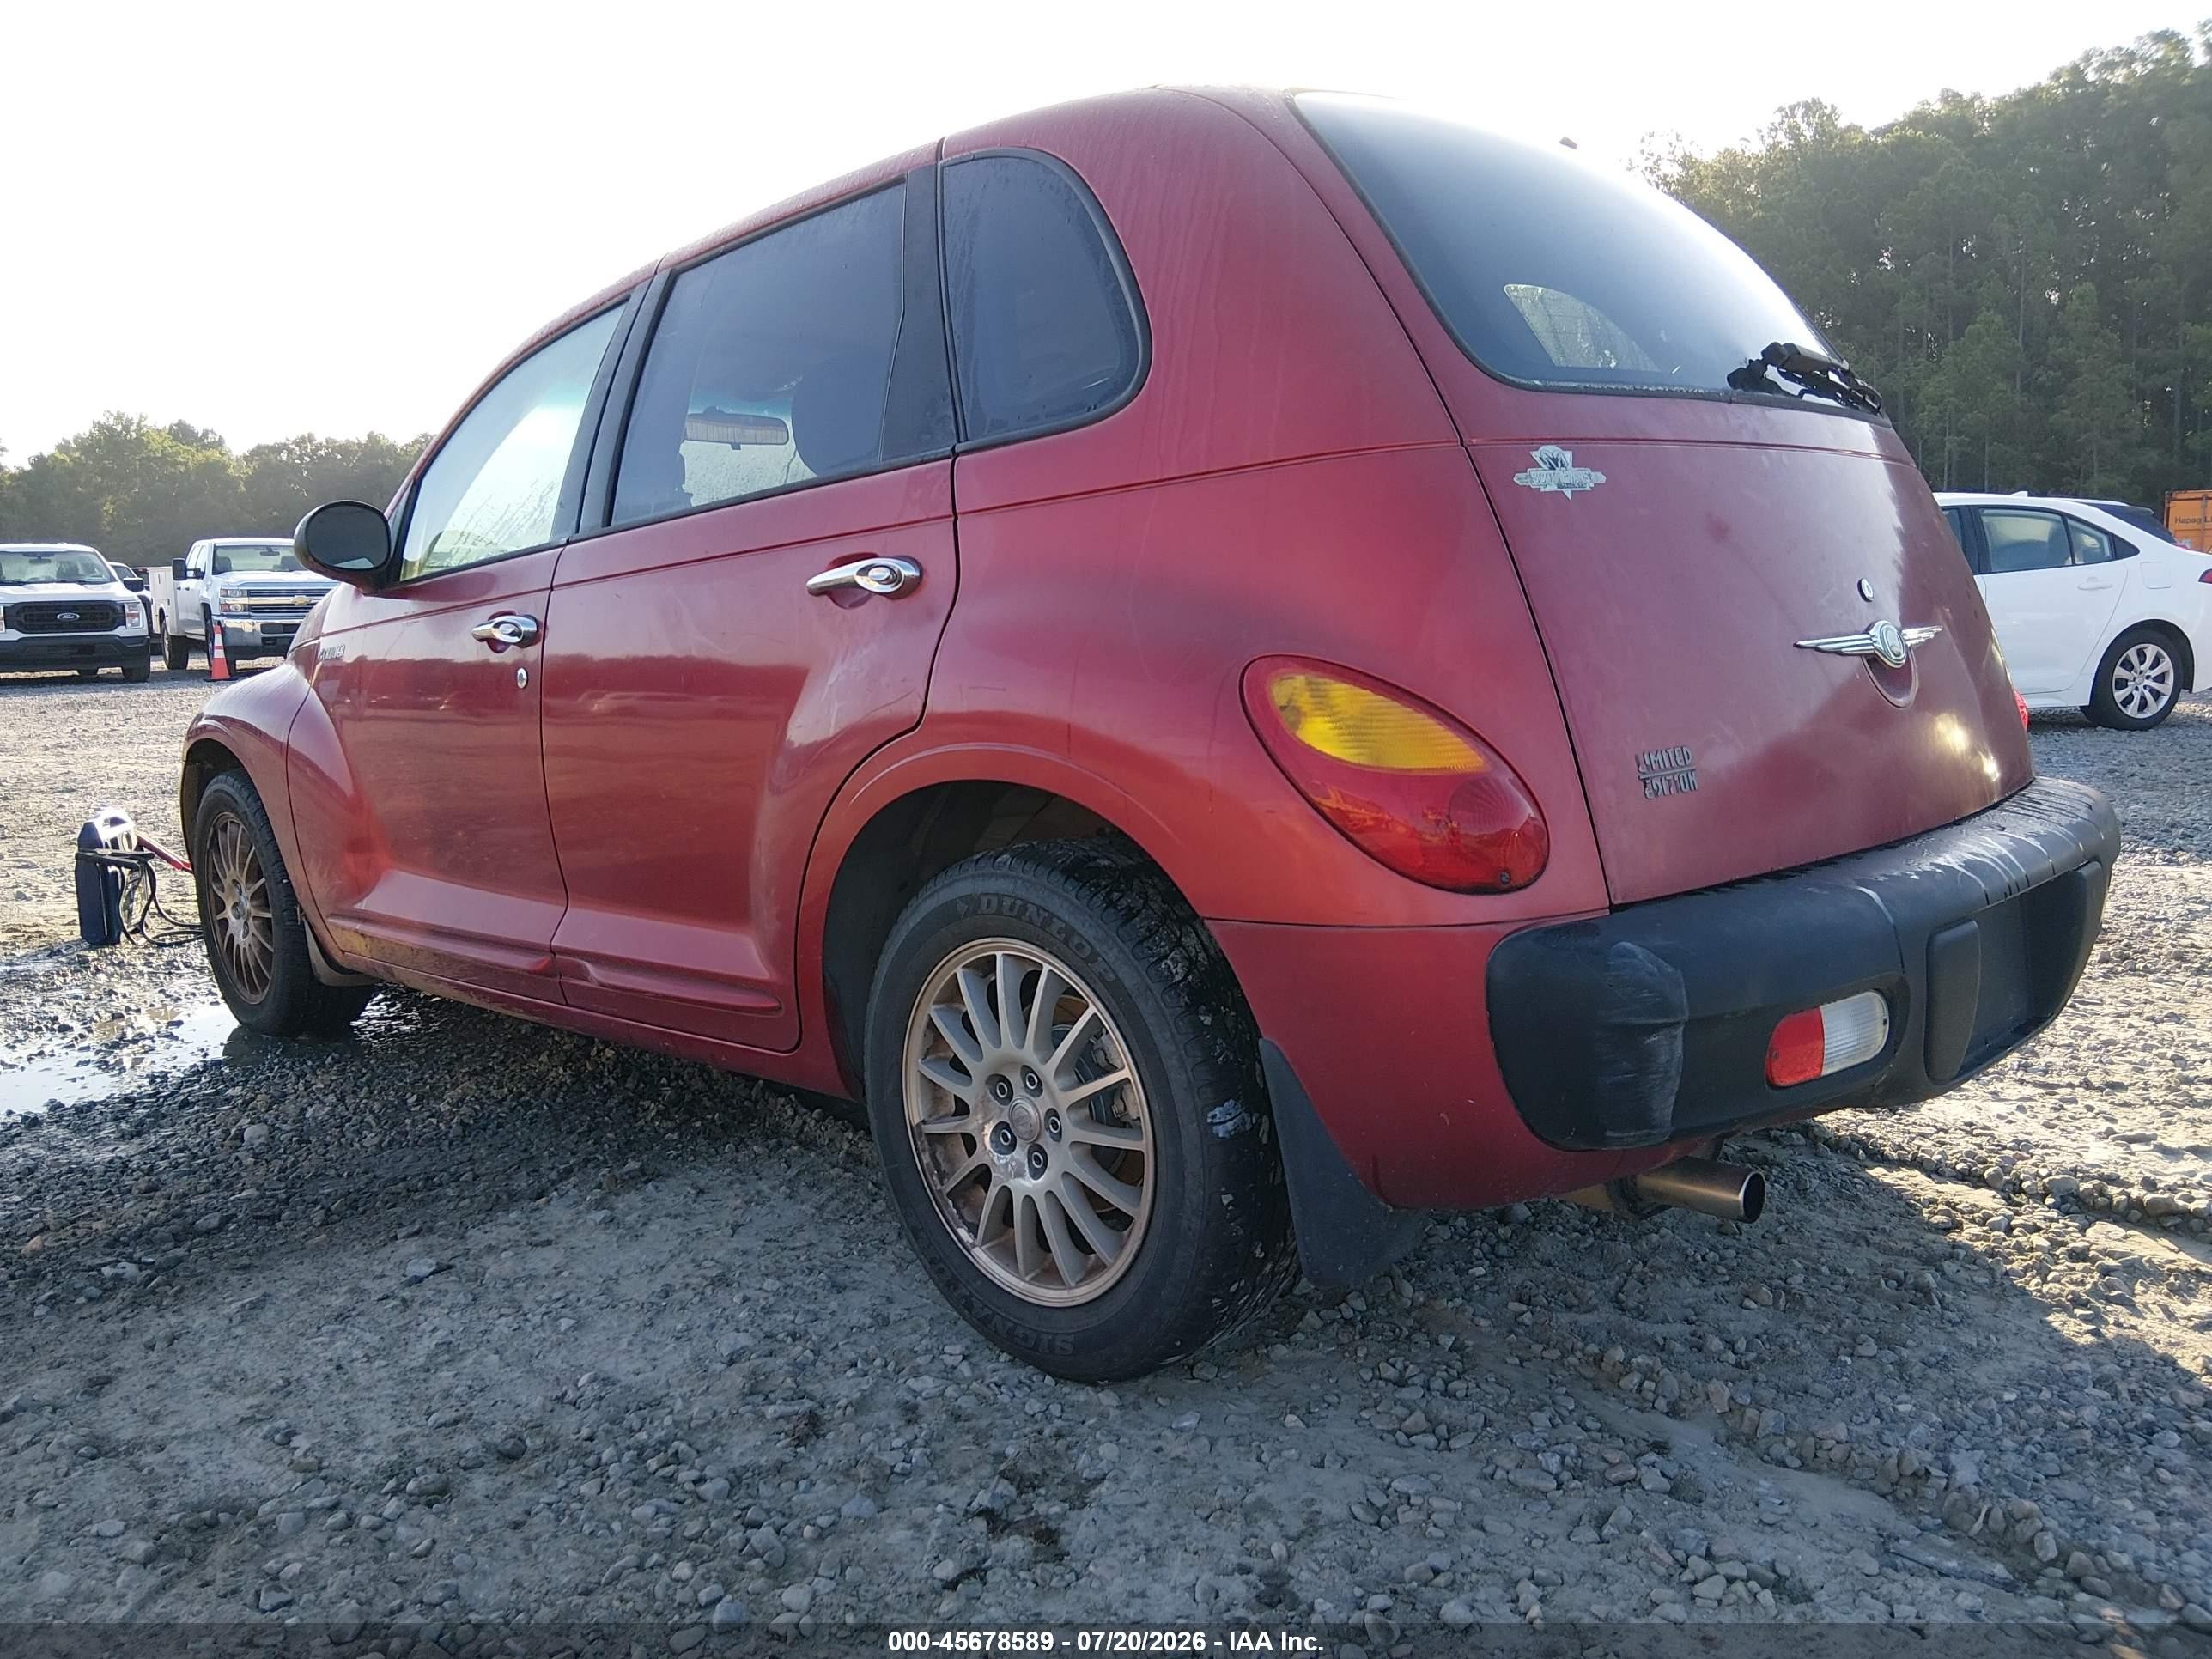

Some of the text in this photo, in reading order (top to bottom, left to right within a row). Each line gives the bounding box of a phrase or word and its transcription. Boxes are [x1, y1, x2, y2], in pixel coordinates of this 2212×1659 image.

[1636, 746, 1692, 773] LIMITED
[1641, 772, 1698, 799] EDITION
[977, 894, 1117, 982] DUNLOP
